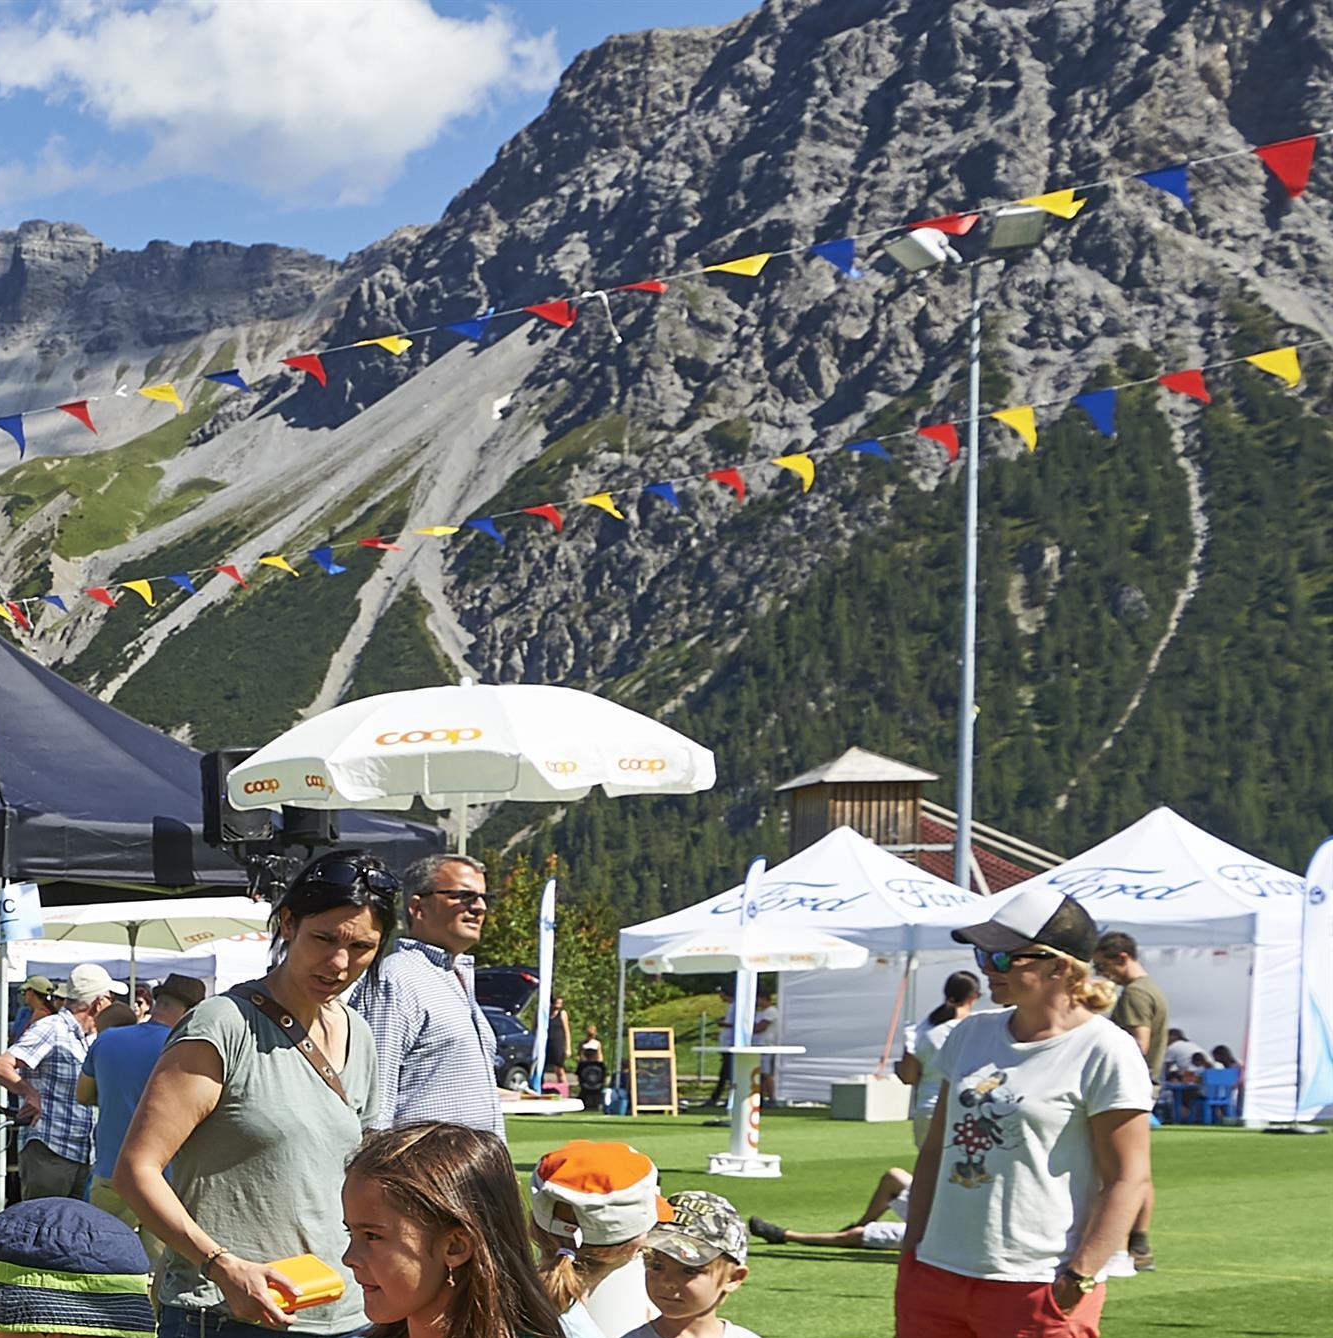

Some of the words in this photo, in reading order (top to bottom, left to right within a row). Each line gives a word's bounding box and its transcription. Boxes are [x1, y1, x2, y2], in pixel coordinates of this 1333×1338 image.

[375, 727, 482, 745] coop
[618, 758, 666, 772] coop
[243, 778, 280, 794] coop
[1047, 867, 1204, 900] Ford
[711, 881, 871, 915] Ford
